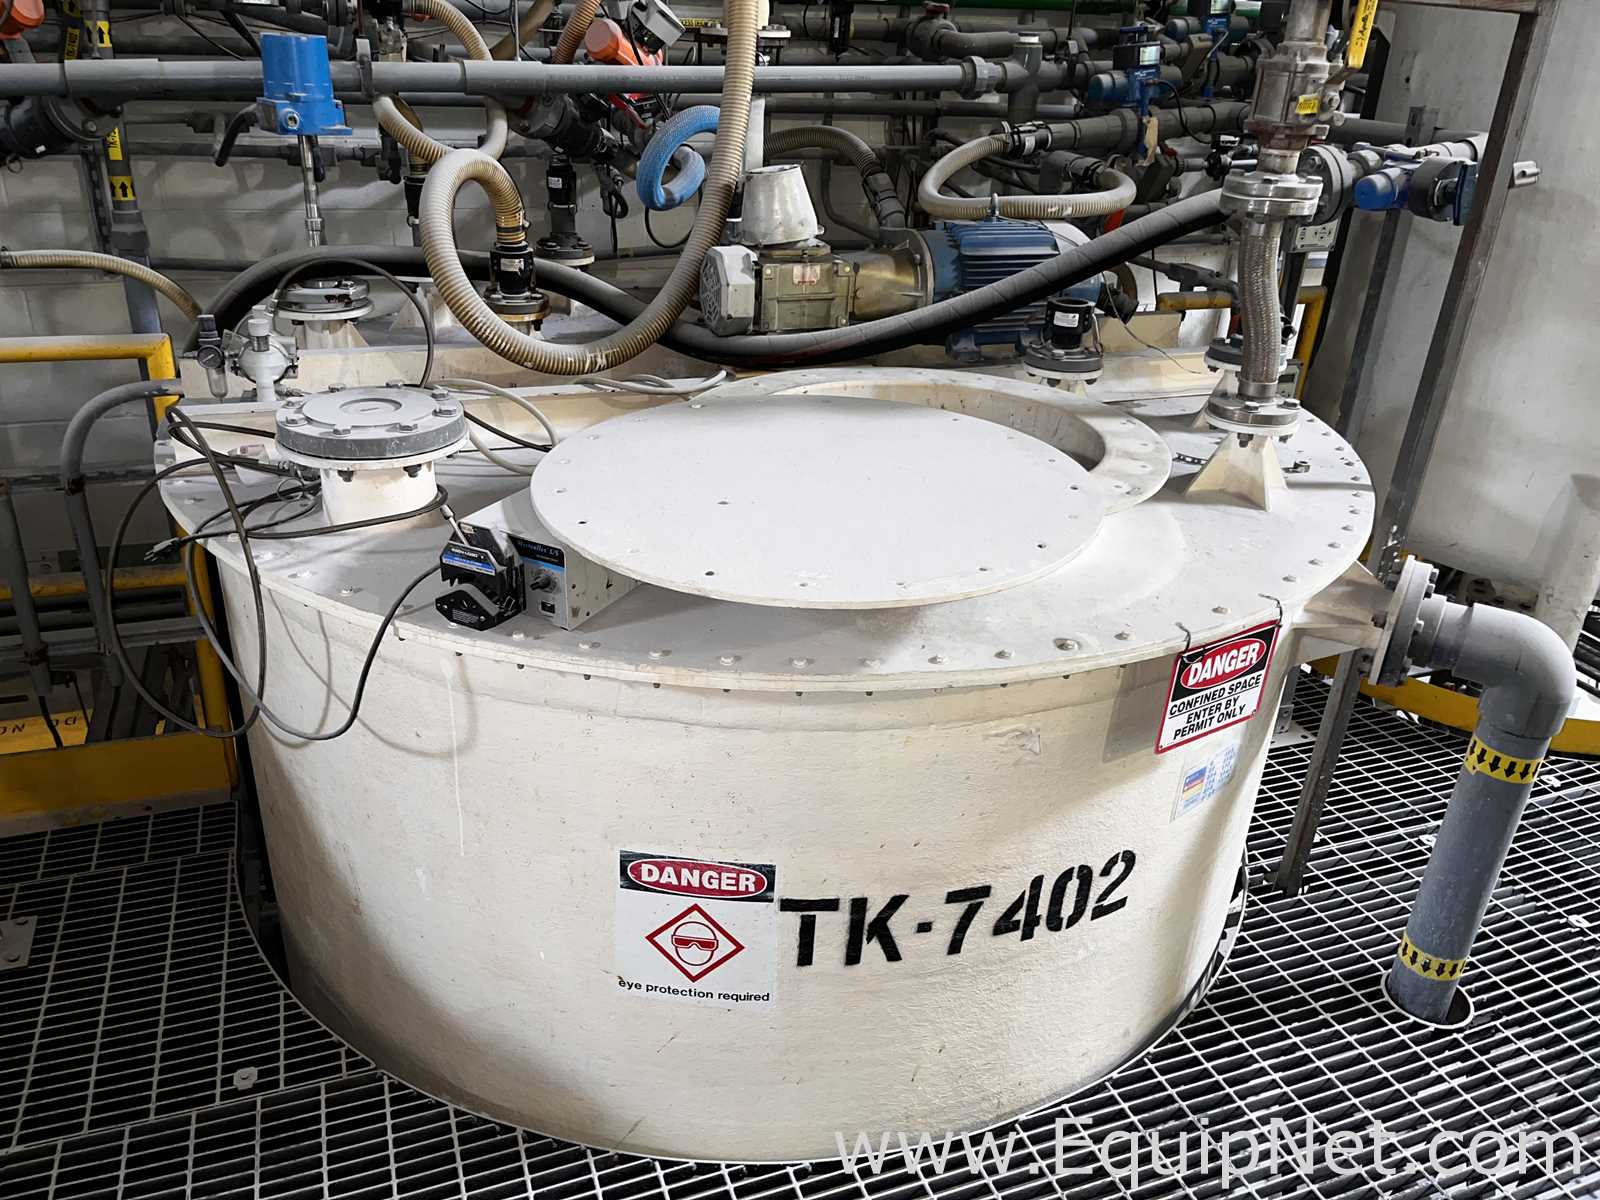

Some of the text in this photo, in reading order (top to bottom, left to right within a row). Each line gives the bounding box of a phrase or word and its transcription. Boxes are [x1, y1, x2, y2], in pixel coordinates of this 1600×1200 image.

[1187, 642, 1260, 687] DANGER
[1169, 674, 1262, 716] CONFINED SPACE
[1186, 696, 1240, 724] ENTER BY
[1173, 704, 1247, 740] PERMIT ONLY
[640, 863, 756, 892] DANGER
[780, 850, 1136, 967] TK-7402
[618, 979, 770, 1002] eye protection required
